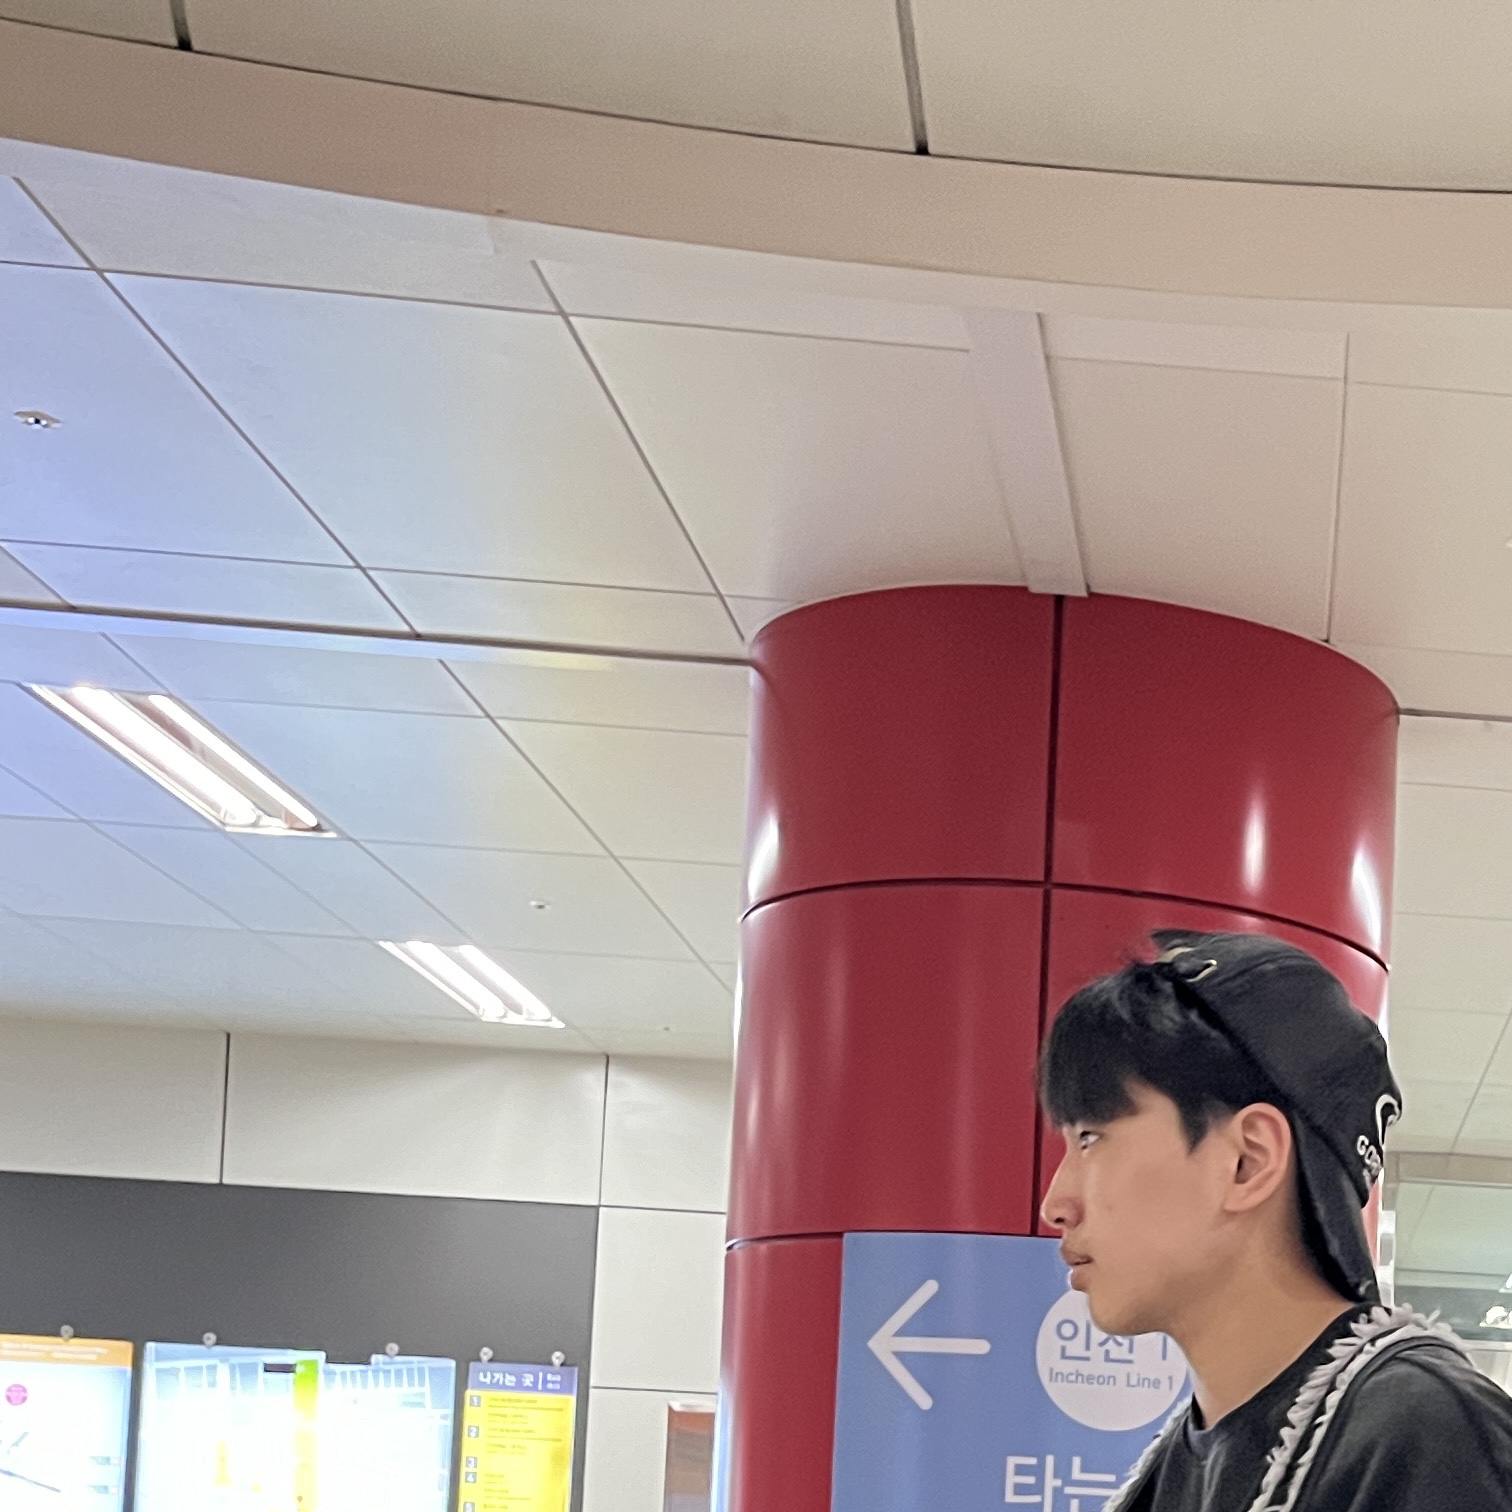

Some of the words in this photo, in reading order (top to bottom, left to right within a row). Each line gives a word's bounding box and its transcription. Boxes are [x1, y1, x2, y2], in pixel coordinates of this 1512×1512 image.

[478, 1371, 517, 1387] 나가는
[1049, 1367, 1117, 1386] Incheon
[1126, 1371, 1162, 1389] Line
[1167, 1375, 1174, 1391] 1
